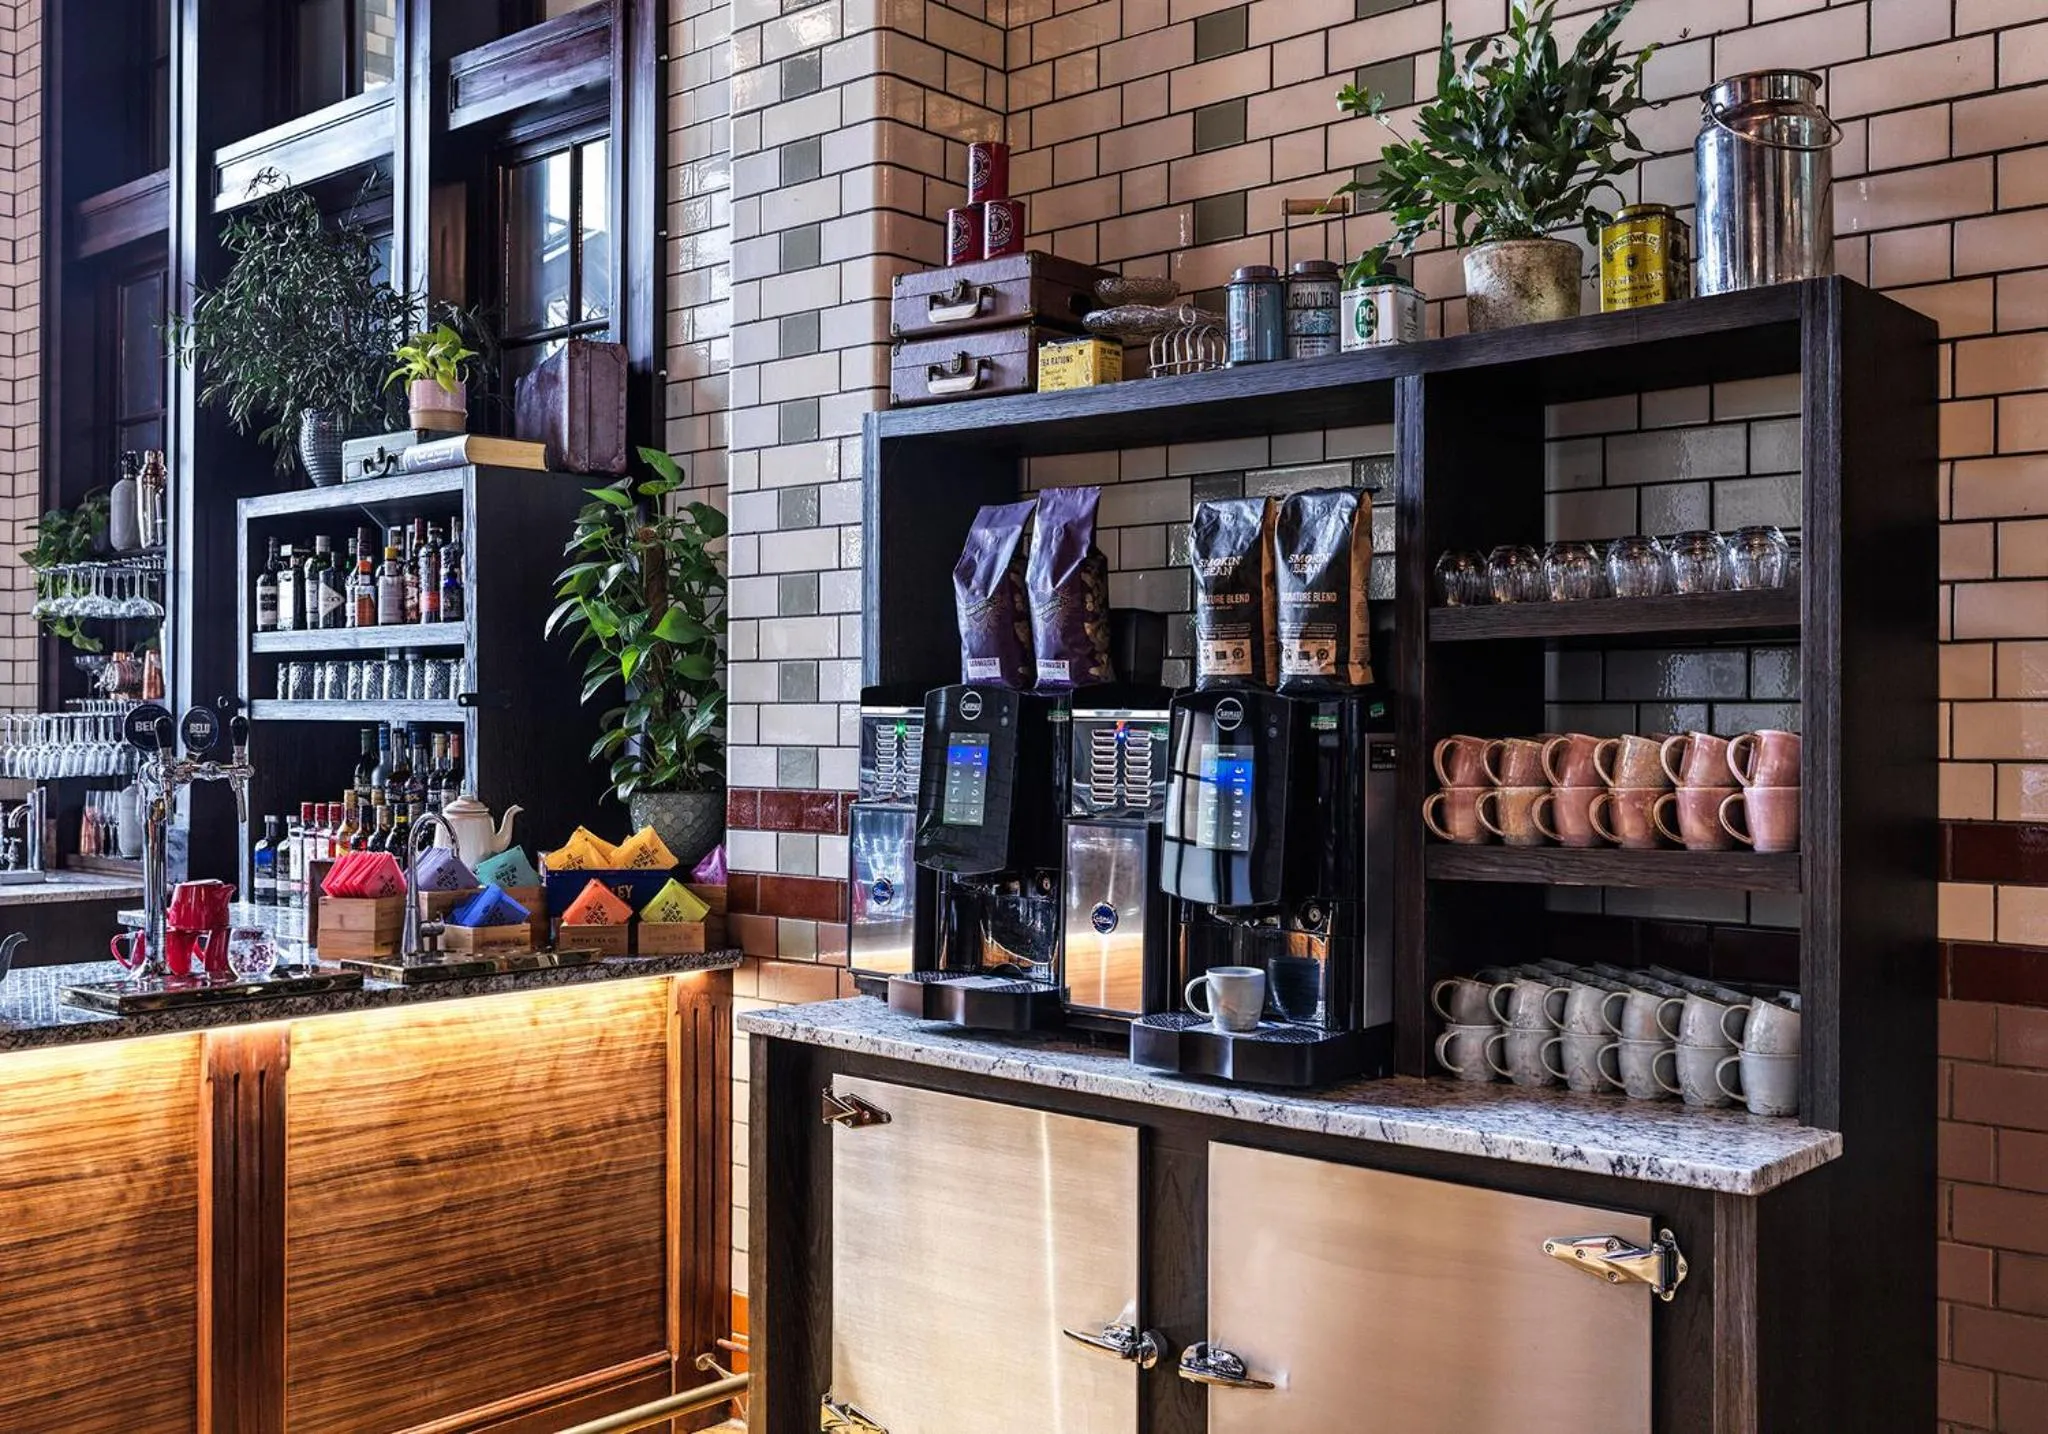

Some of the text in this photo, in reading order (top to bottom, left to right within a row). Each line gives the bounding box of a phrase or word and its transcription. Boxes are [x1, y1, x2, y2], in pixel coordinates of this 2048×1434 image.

[1359, 303, 1373, 322] PG
[1203, 565, 1233, 577] BEAN
[1226, 593, 1250, 604] BLEND
[1313, 592, 1338, 602] BLEND
[135, 721, 155, 732] BEL
